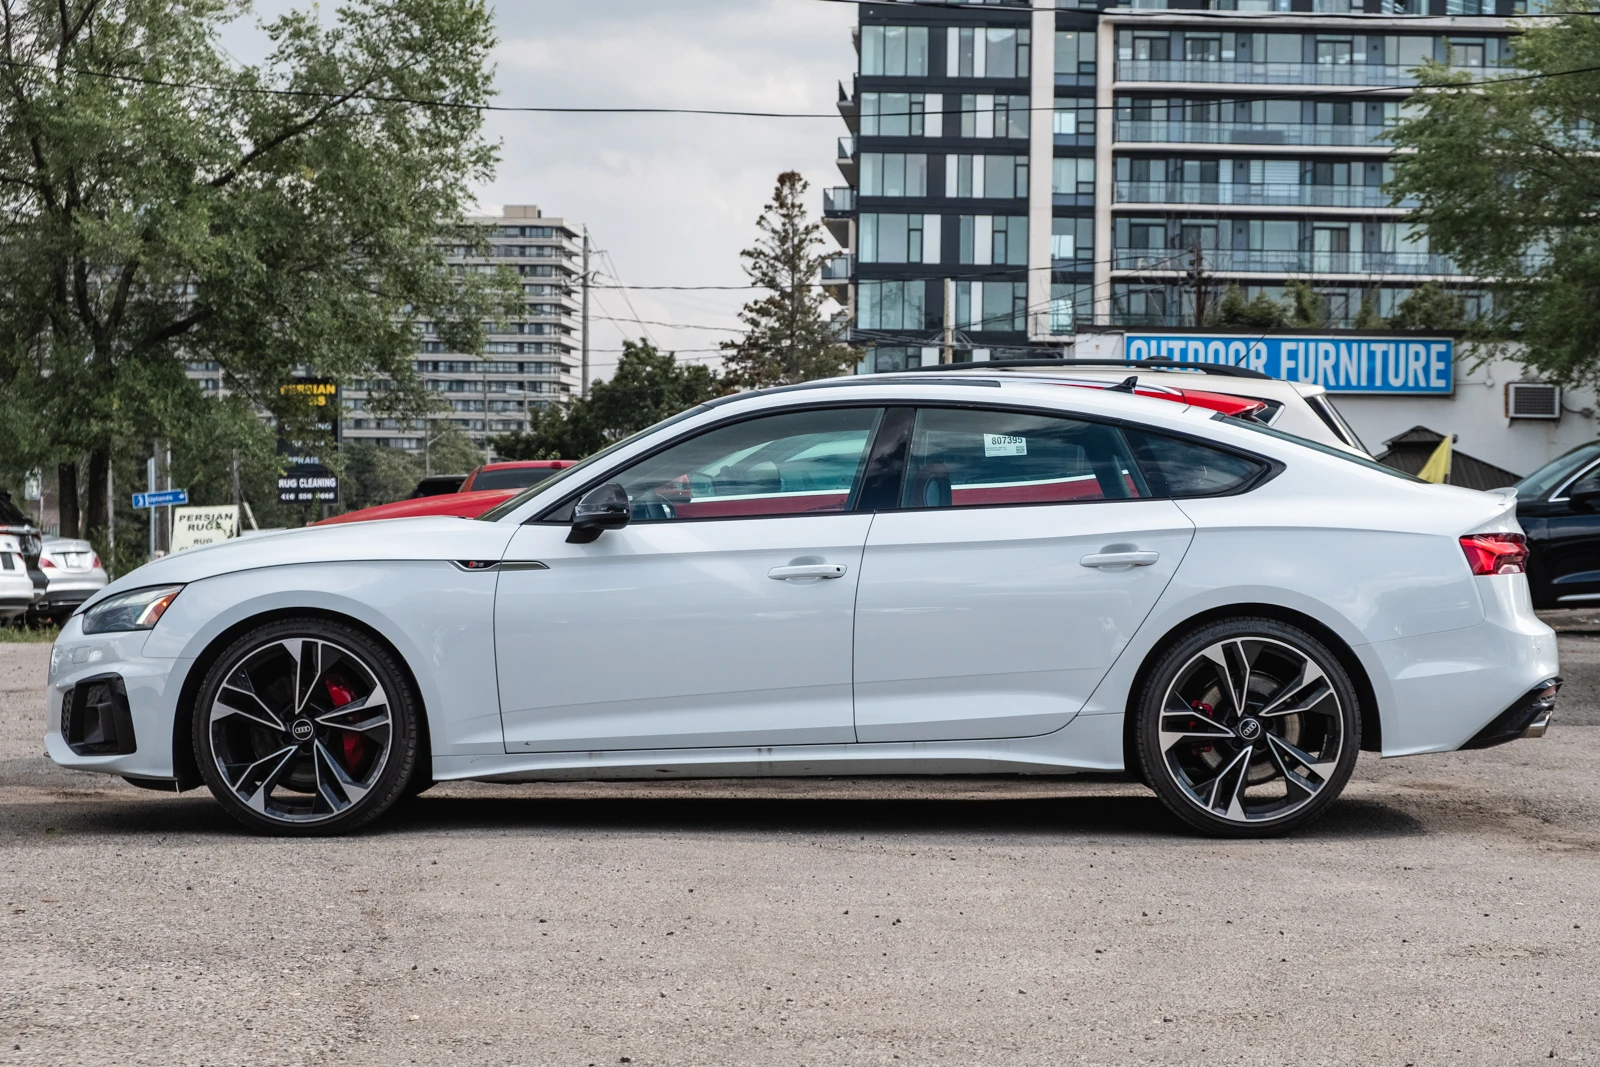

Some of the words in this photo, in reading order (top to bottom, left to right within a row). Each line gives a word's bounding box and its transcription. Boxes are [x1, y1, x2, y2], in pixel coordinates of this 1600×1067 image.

[1129, 339, 1268, 375] OUTDOOR
[1280, 342, 1447, 387] FURNITURE
[991, 436, 1023, 445] 807395
[278, 478, 298, 488] RUG
[299, 477, 337, 488] CLEANING
[179, 512, 233, 522] PERSIAN
